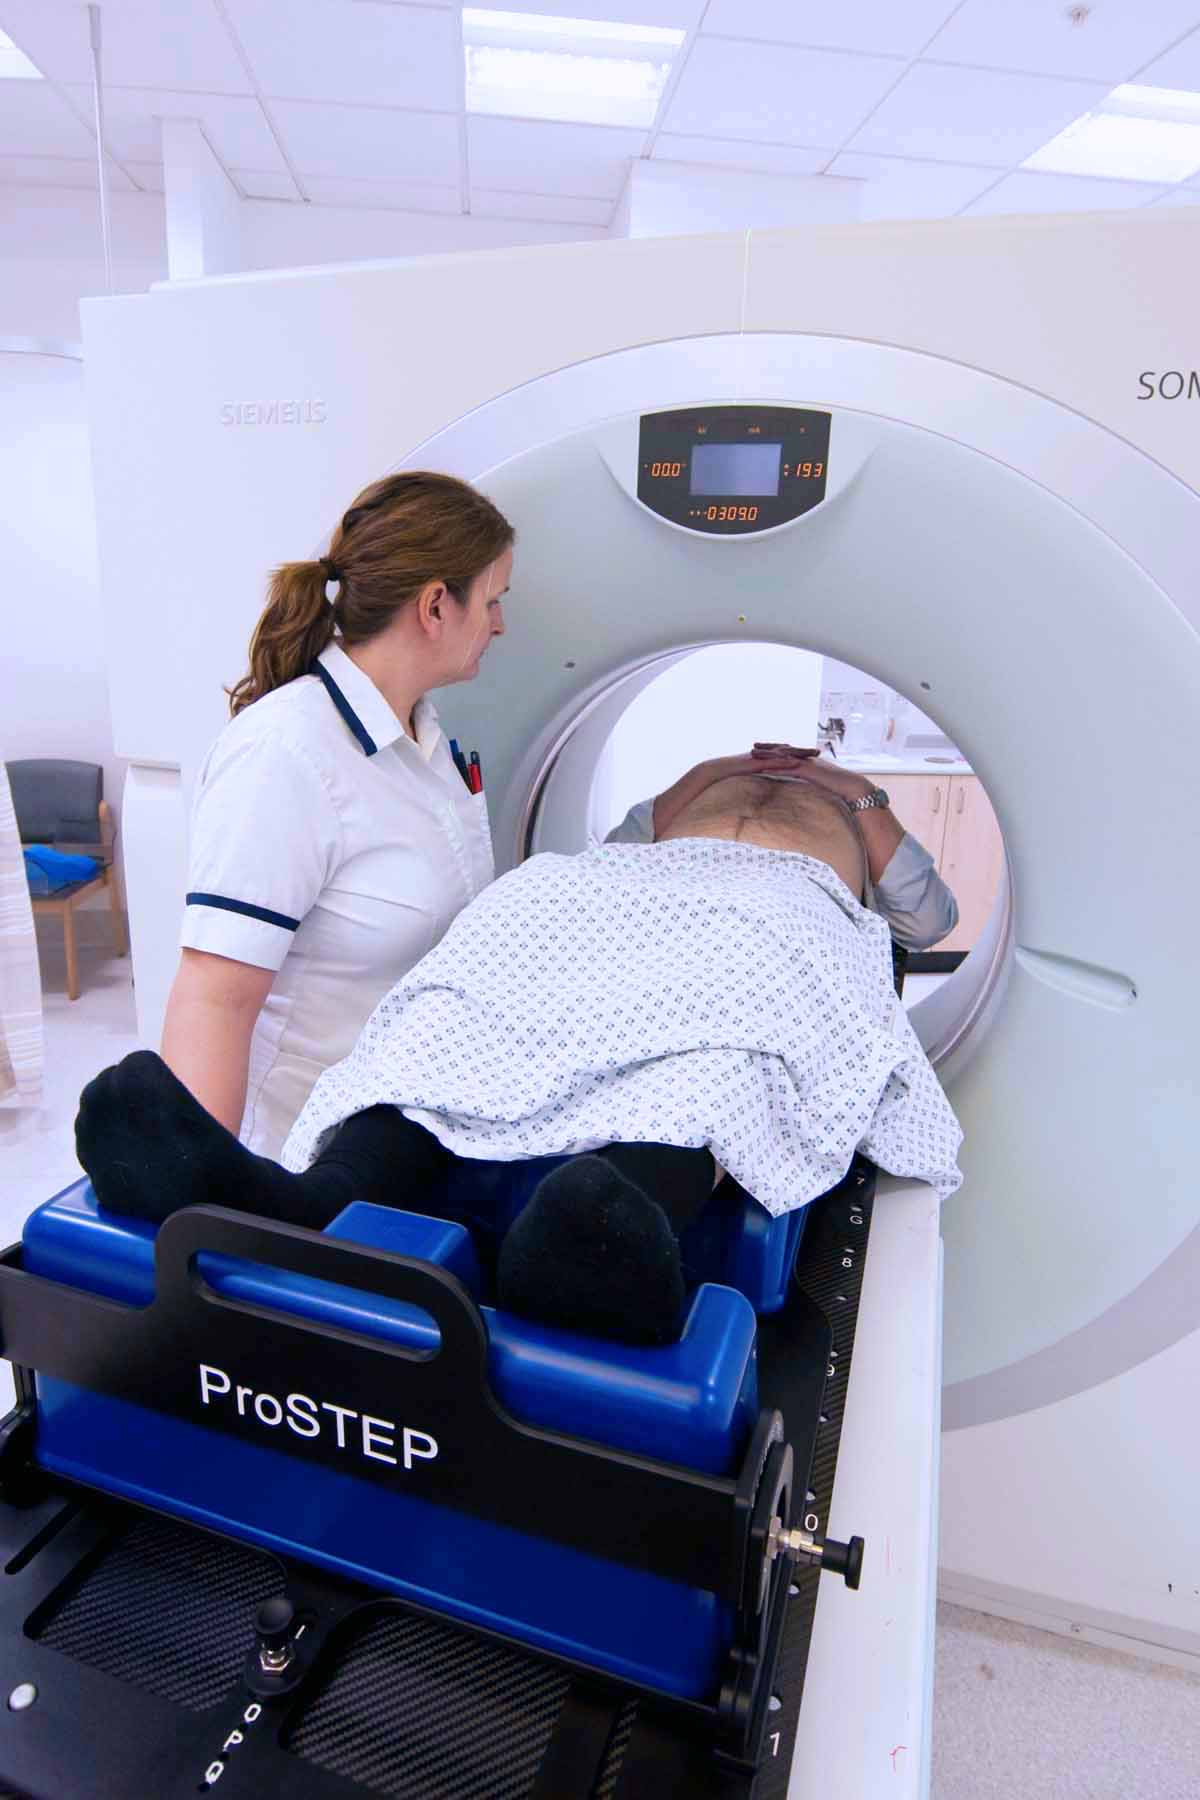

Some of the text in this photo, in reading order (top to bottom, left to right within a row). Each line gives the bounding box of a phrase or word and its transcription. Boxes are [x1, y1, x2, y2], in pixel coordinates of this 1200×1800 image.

[216, 399, 328, 425] SIEMENS
[842, 1257, 853, 1268] 8
[199, 1363, 439, 1470] ProSTEP
[222, 1729, 244, 1752] P
